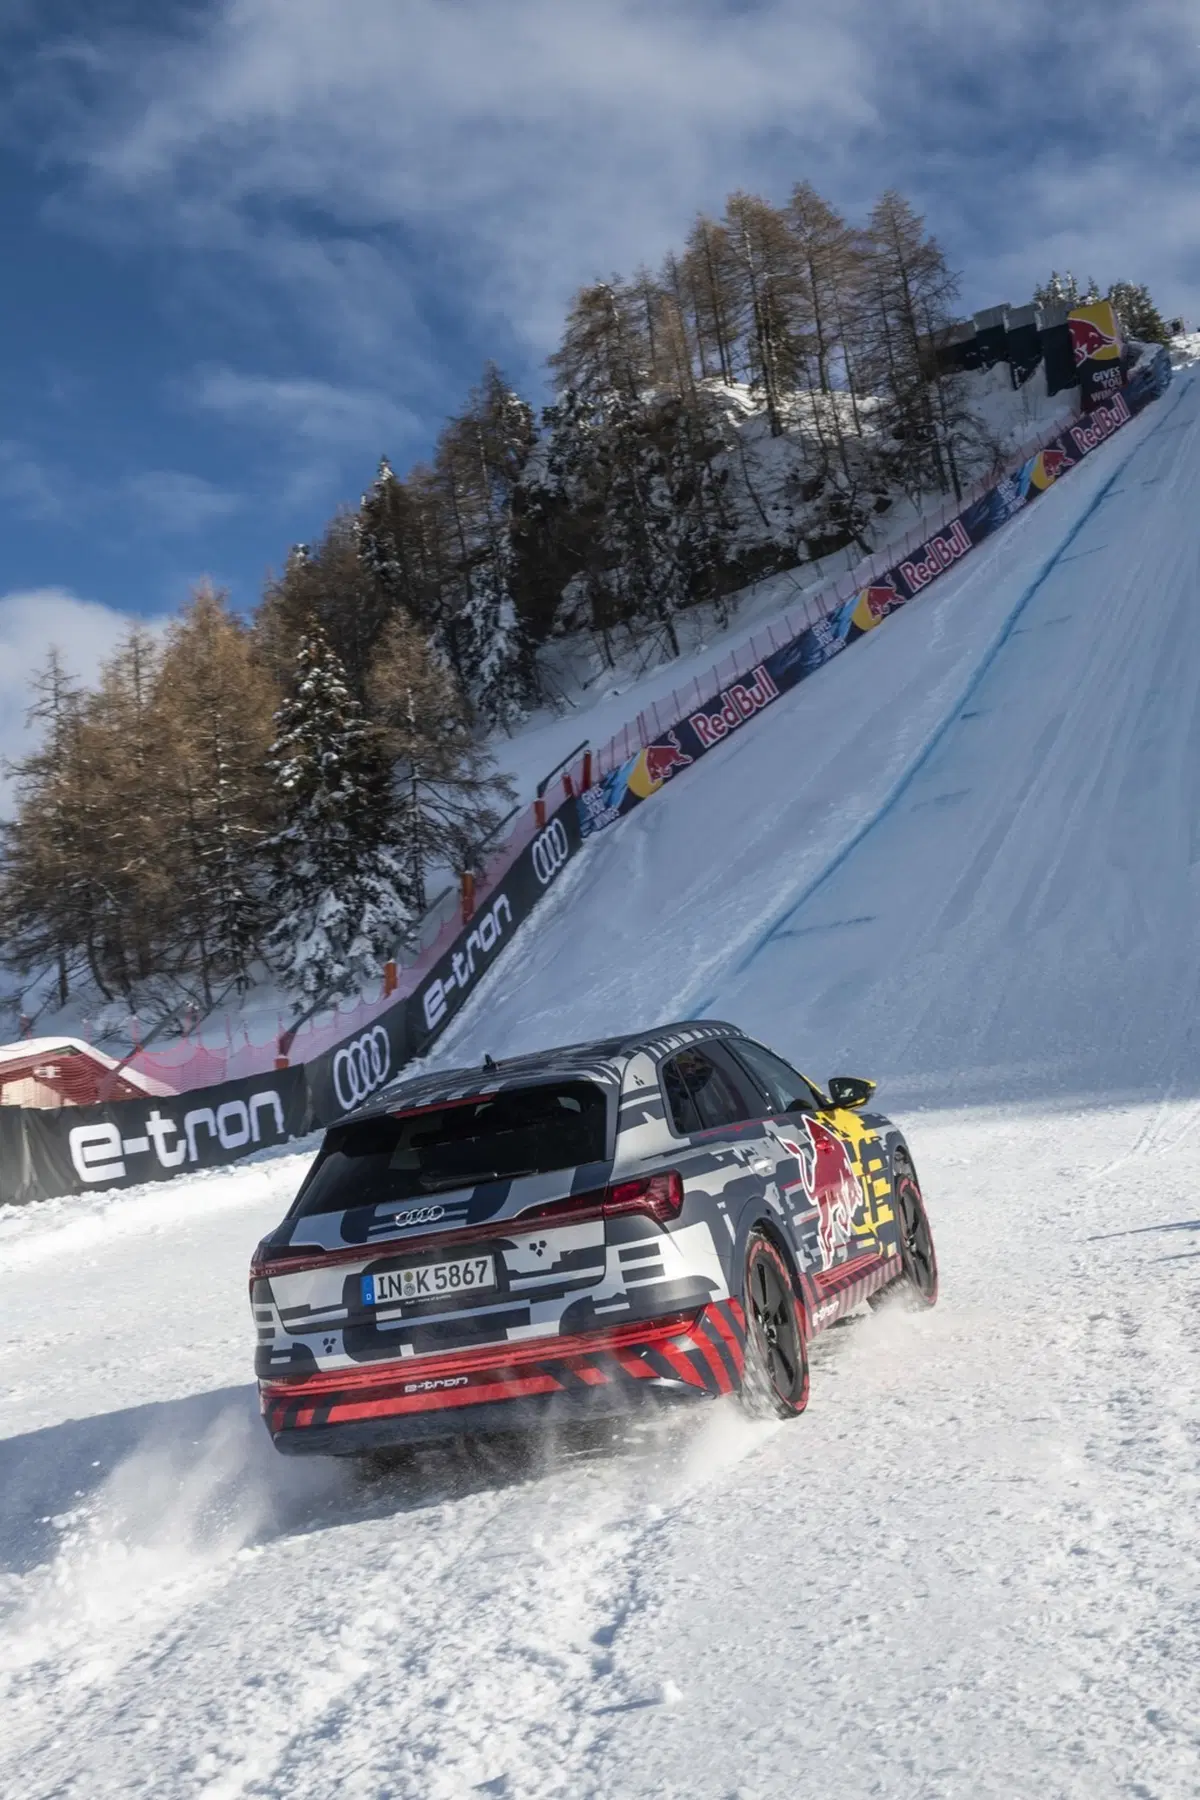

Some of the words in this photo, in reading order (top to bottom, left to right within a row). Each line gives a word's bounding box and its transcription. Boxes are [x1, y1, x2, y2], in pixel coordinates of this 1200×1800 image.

[1092, 366, 1120, 382] GIVES
[1102, 376, 1122, 389] YOU
[423, 893, 513, 1030] e-tron
[69, 1090, 285, 1183] e-tron
[377, 1274, 402, 1300] IN
[434, 1260, 488, 1290] 5867
[404, 1376, 468, 1393] e-tron
